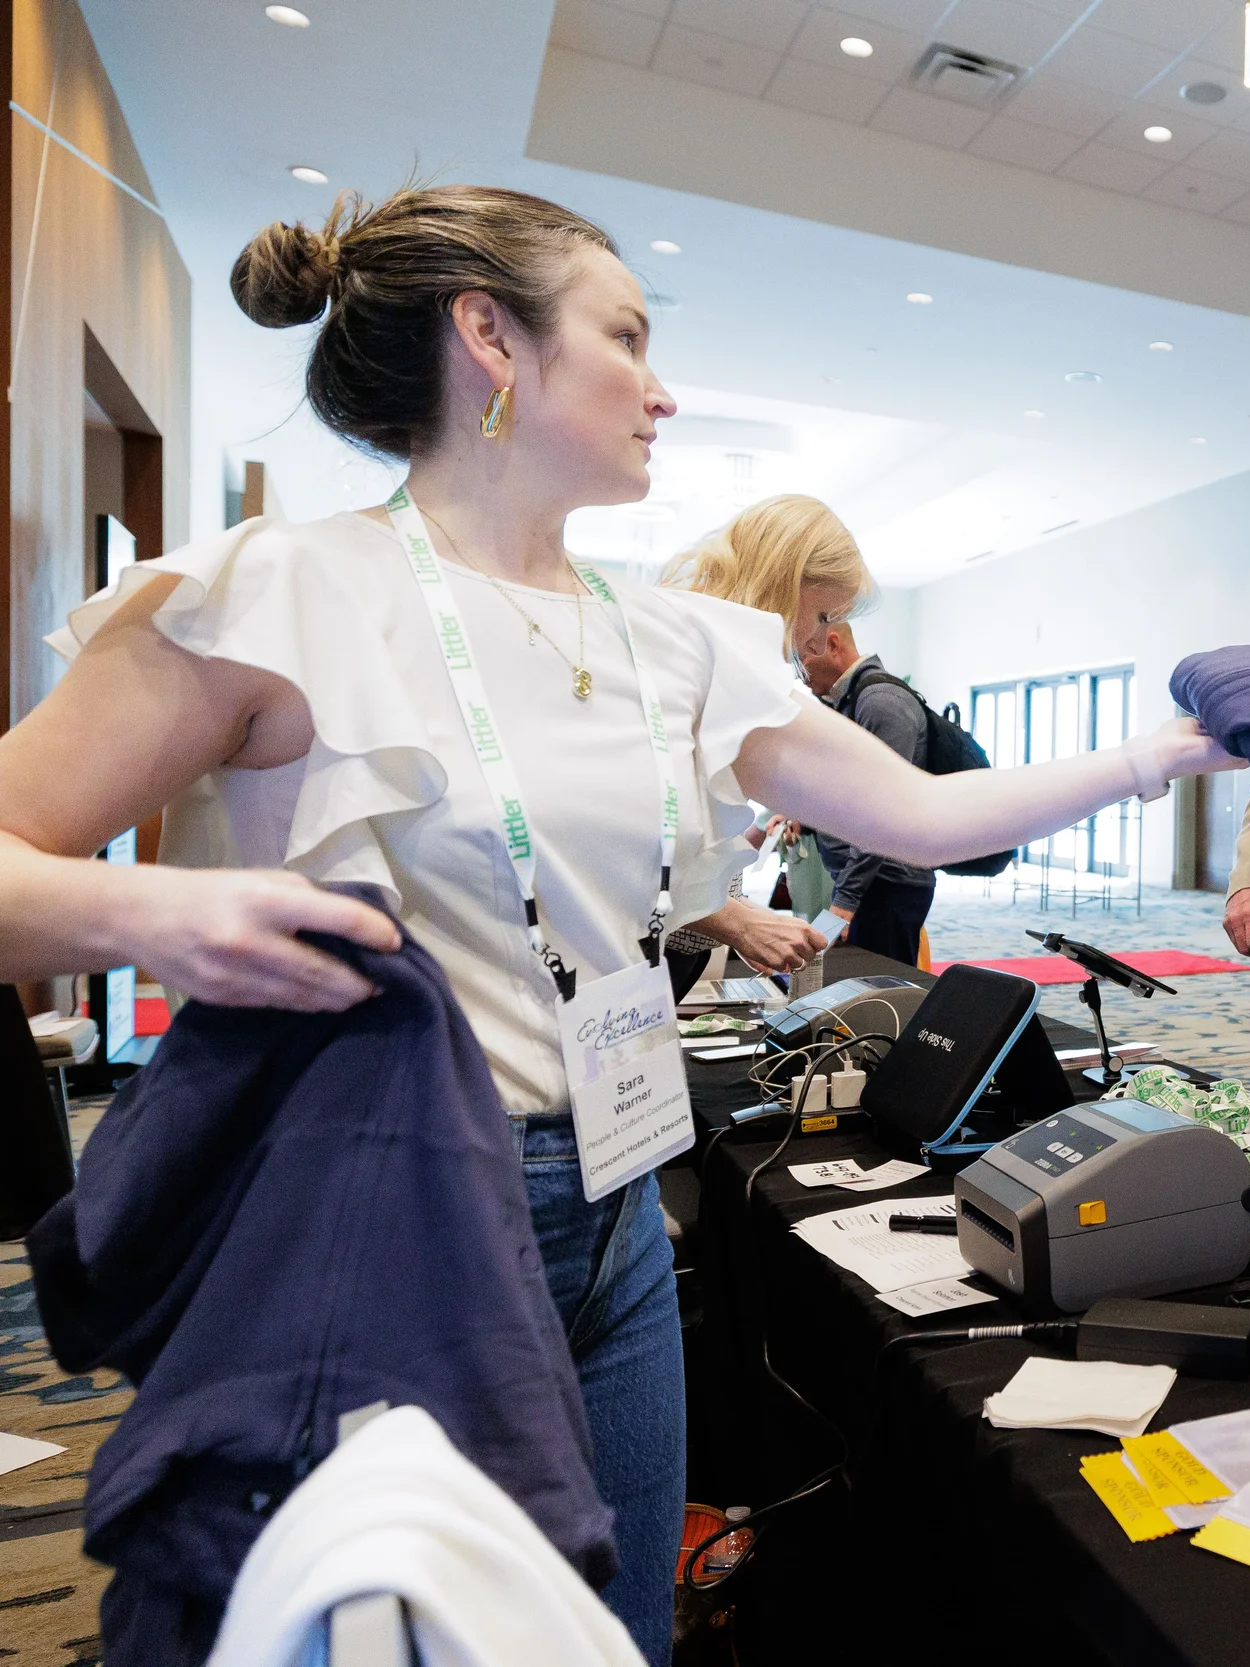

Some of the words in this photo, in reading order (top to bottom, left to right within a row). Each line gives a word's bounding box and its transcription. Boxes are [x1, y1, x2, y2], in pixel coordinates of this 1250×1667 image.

[406, 533, 442, 583] Littler
[438, 612, 472, 670] Littler
[468, 701, 503, 763] Littler
[650, 697, 668, 752] Littler
[501, 794, 530, 860] Littler
[664, 780, 679, 839] Littler
[577, 1008, 636, 1042] Evolving
[594, 1011, 663, 1050] Excellence
[918, 1028, 929, 1042] Up
[927, 1032, 943, 1046] Side
[940, 1037, 955, 1051] This
[617, 1074, 645, 1095] Sara
[1133, 1068, 1165, 1089] Littler
[613, 1088, 652, 1116] Warner
[1159, 1088, 1183, 1111] Littler
[586, 1134, 612, 1152] People
[613, 1127, 619, 1137] &
[620, 1113, 645, 1132] Culture
[646, 1091, 684, 1117] Coordinator
[589, 1150, 625, 1176] Crescent
[626, 1136, 651, 1155] Hotels
[653, 1130, 659, 1139] &
[660, 1113, 688, 1135] Resorts
[1155, 1447, 1198, 1486] SPONSOR
[1174, 1451, 1207, 1476] GOLD
[1105, 1478, 1143, 1521] SPONSOR
[1124, 1481, 1151, 1508] GOLD
